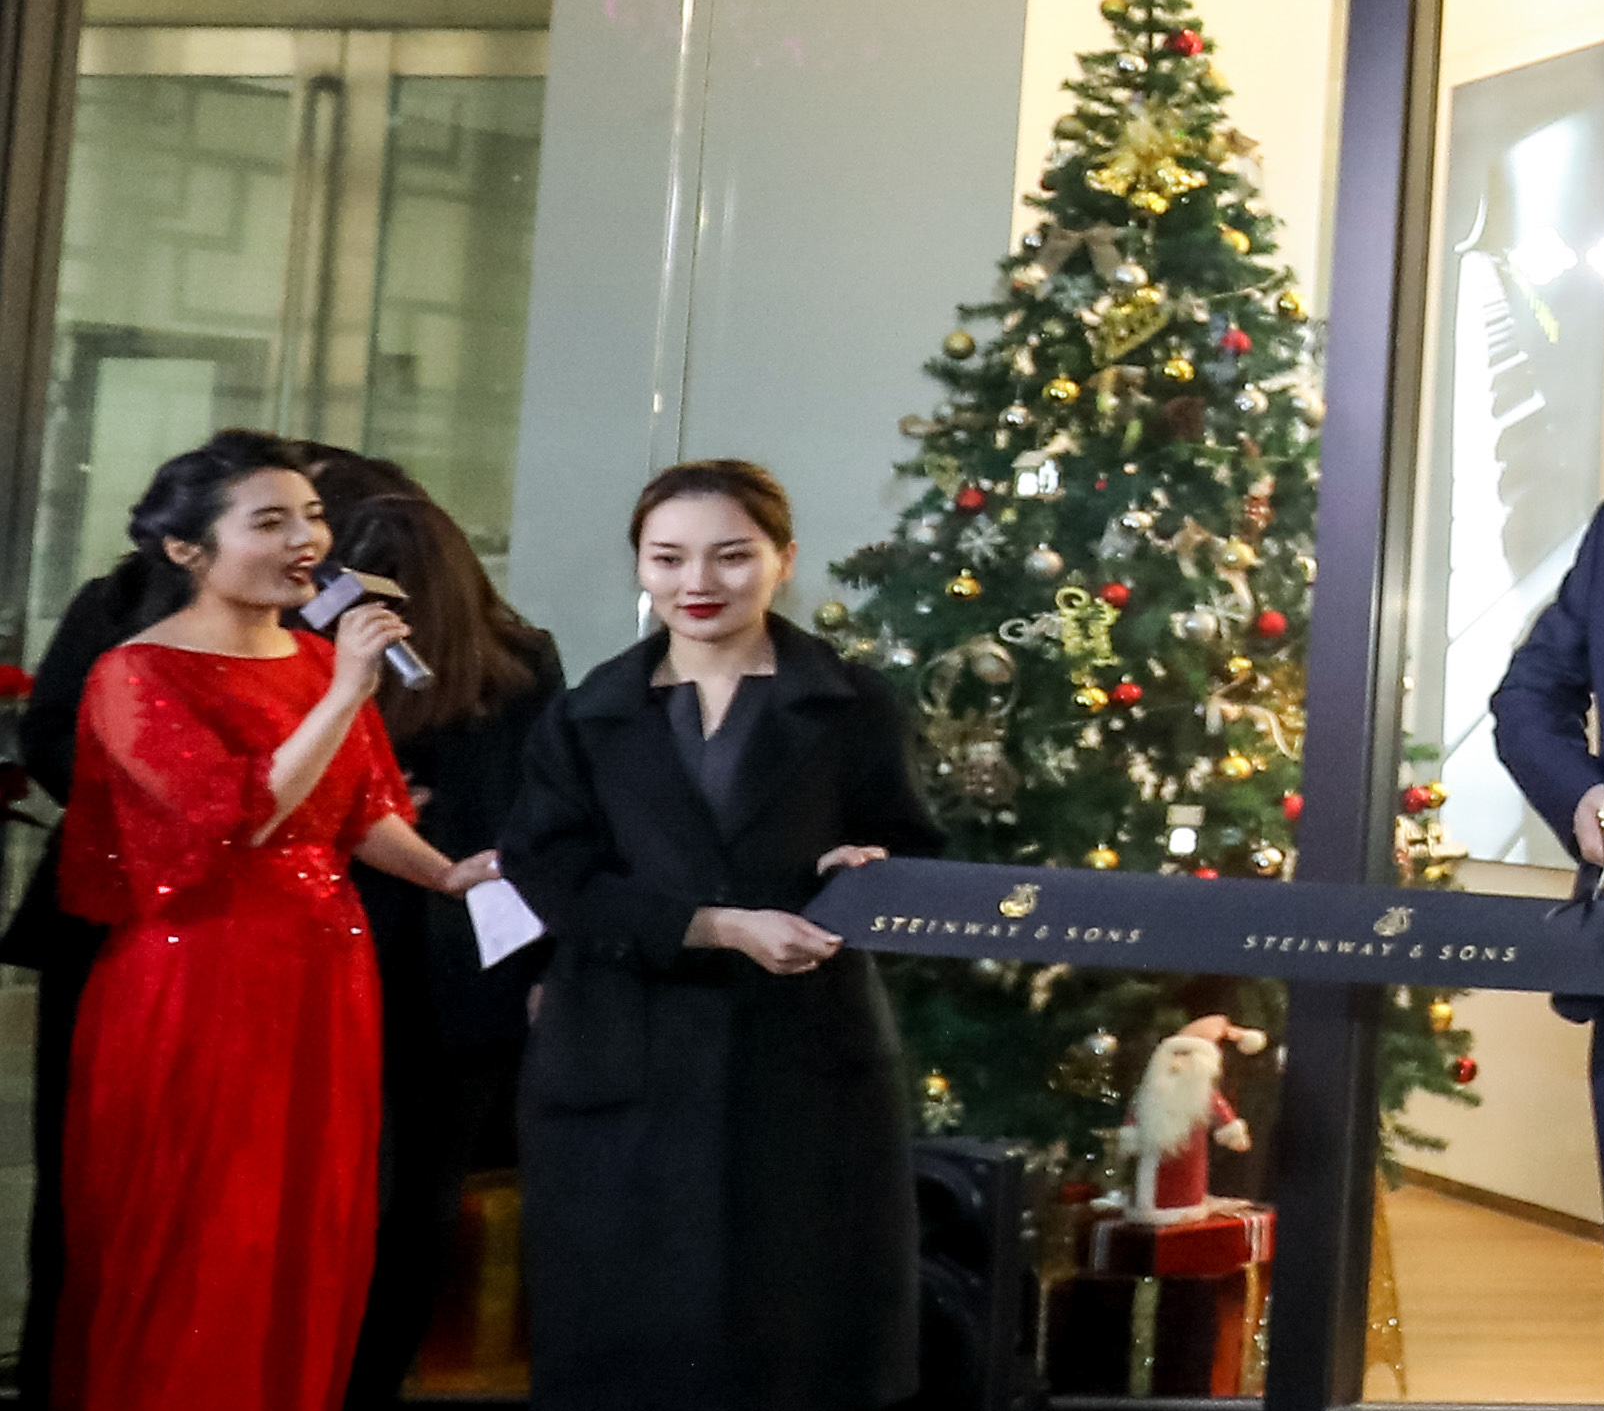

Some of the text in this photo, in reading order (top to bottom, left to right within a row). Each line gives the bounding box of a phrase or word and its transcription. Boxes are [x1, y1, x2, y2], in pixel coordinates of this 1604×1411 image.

[871, 915, 1143, 944] STEINWAY & SONS
[1244, 935, 1517, 962] STEINWAY & SONS
